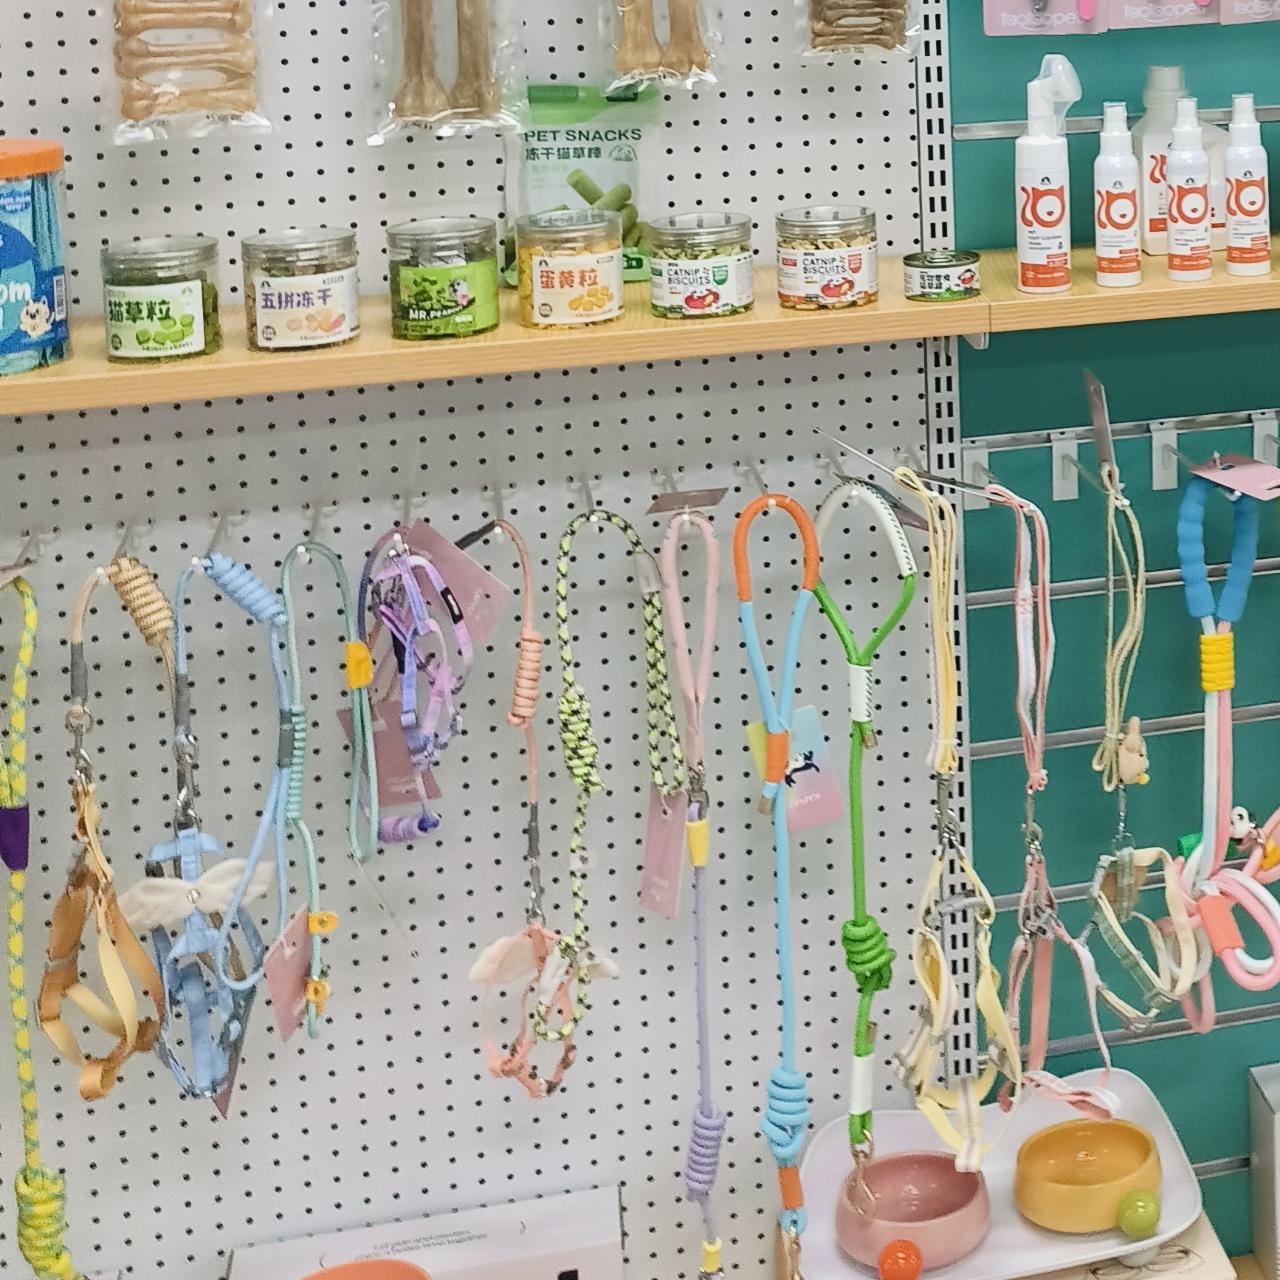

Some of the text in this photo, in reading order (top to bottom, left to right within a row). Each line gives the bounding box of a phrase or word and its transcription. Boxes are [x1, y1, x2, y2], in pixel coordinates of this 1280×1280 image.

[524, 128, 642, 142] PET SNACKS
[803, 258, 837, 266] CATNIP
[667, 268, 700, 276] CATNIP
[803, 266, 847, 274] BISCUITS
[540, 268, 598, 289] 蛋黄粒
[668, 277, 711, 285] BISCUITS
[261, 288, 332, 310] 五拼冻干
